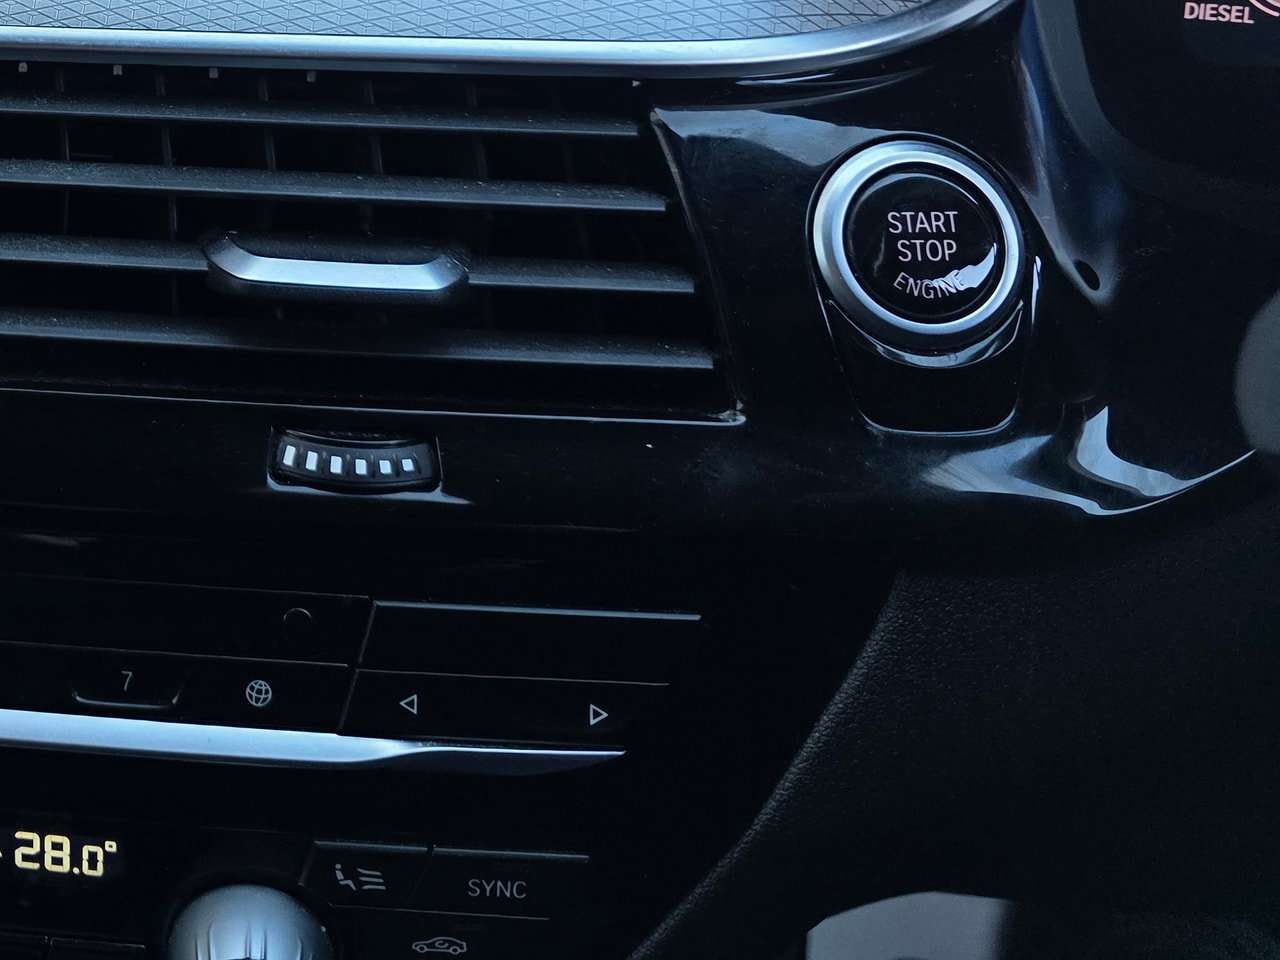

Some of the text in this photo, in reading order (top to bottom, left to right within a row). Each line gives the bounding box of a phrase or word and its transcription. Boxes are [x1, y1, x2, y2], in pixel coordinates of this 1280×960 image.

[1183, 1, 1256, 25] DIESEL
[887, 210, 959, 234] START
[897, 239, 957, 262] STOP
[121, 670, 133, 692] 7
[468, 878, 527, 899] SYNC
